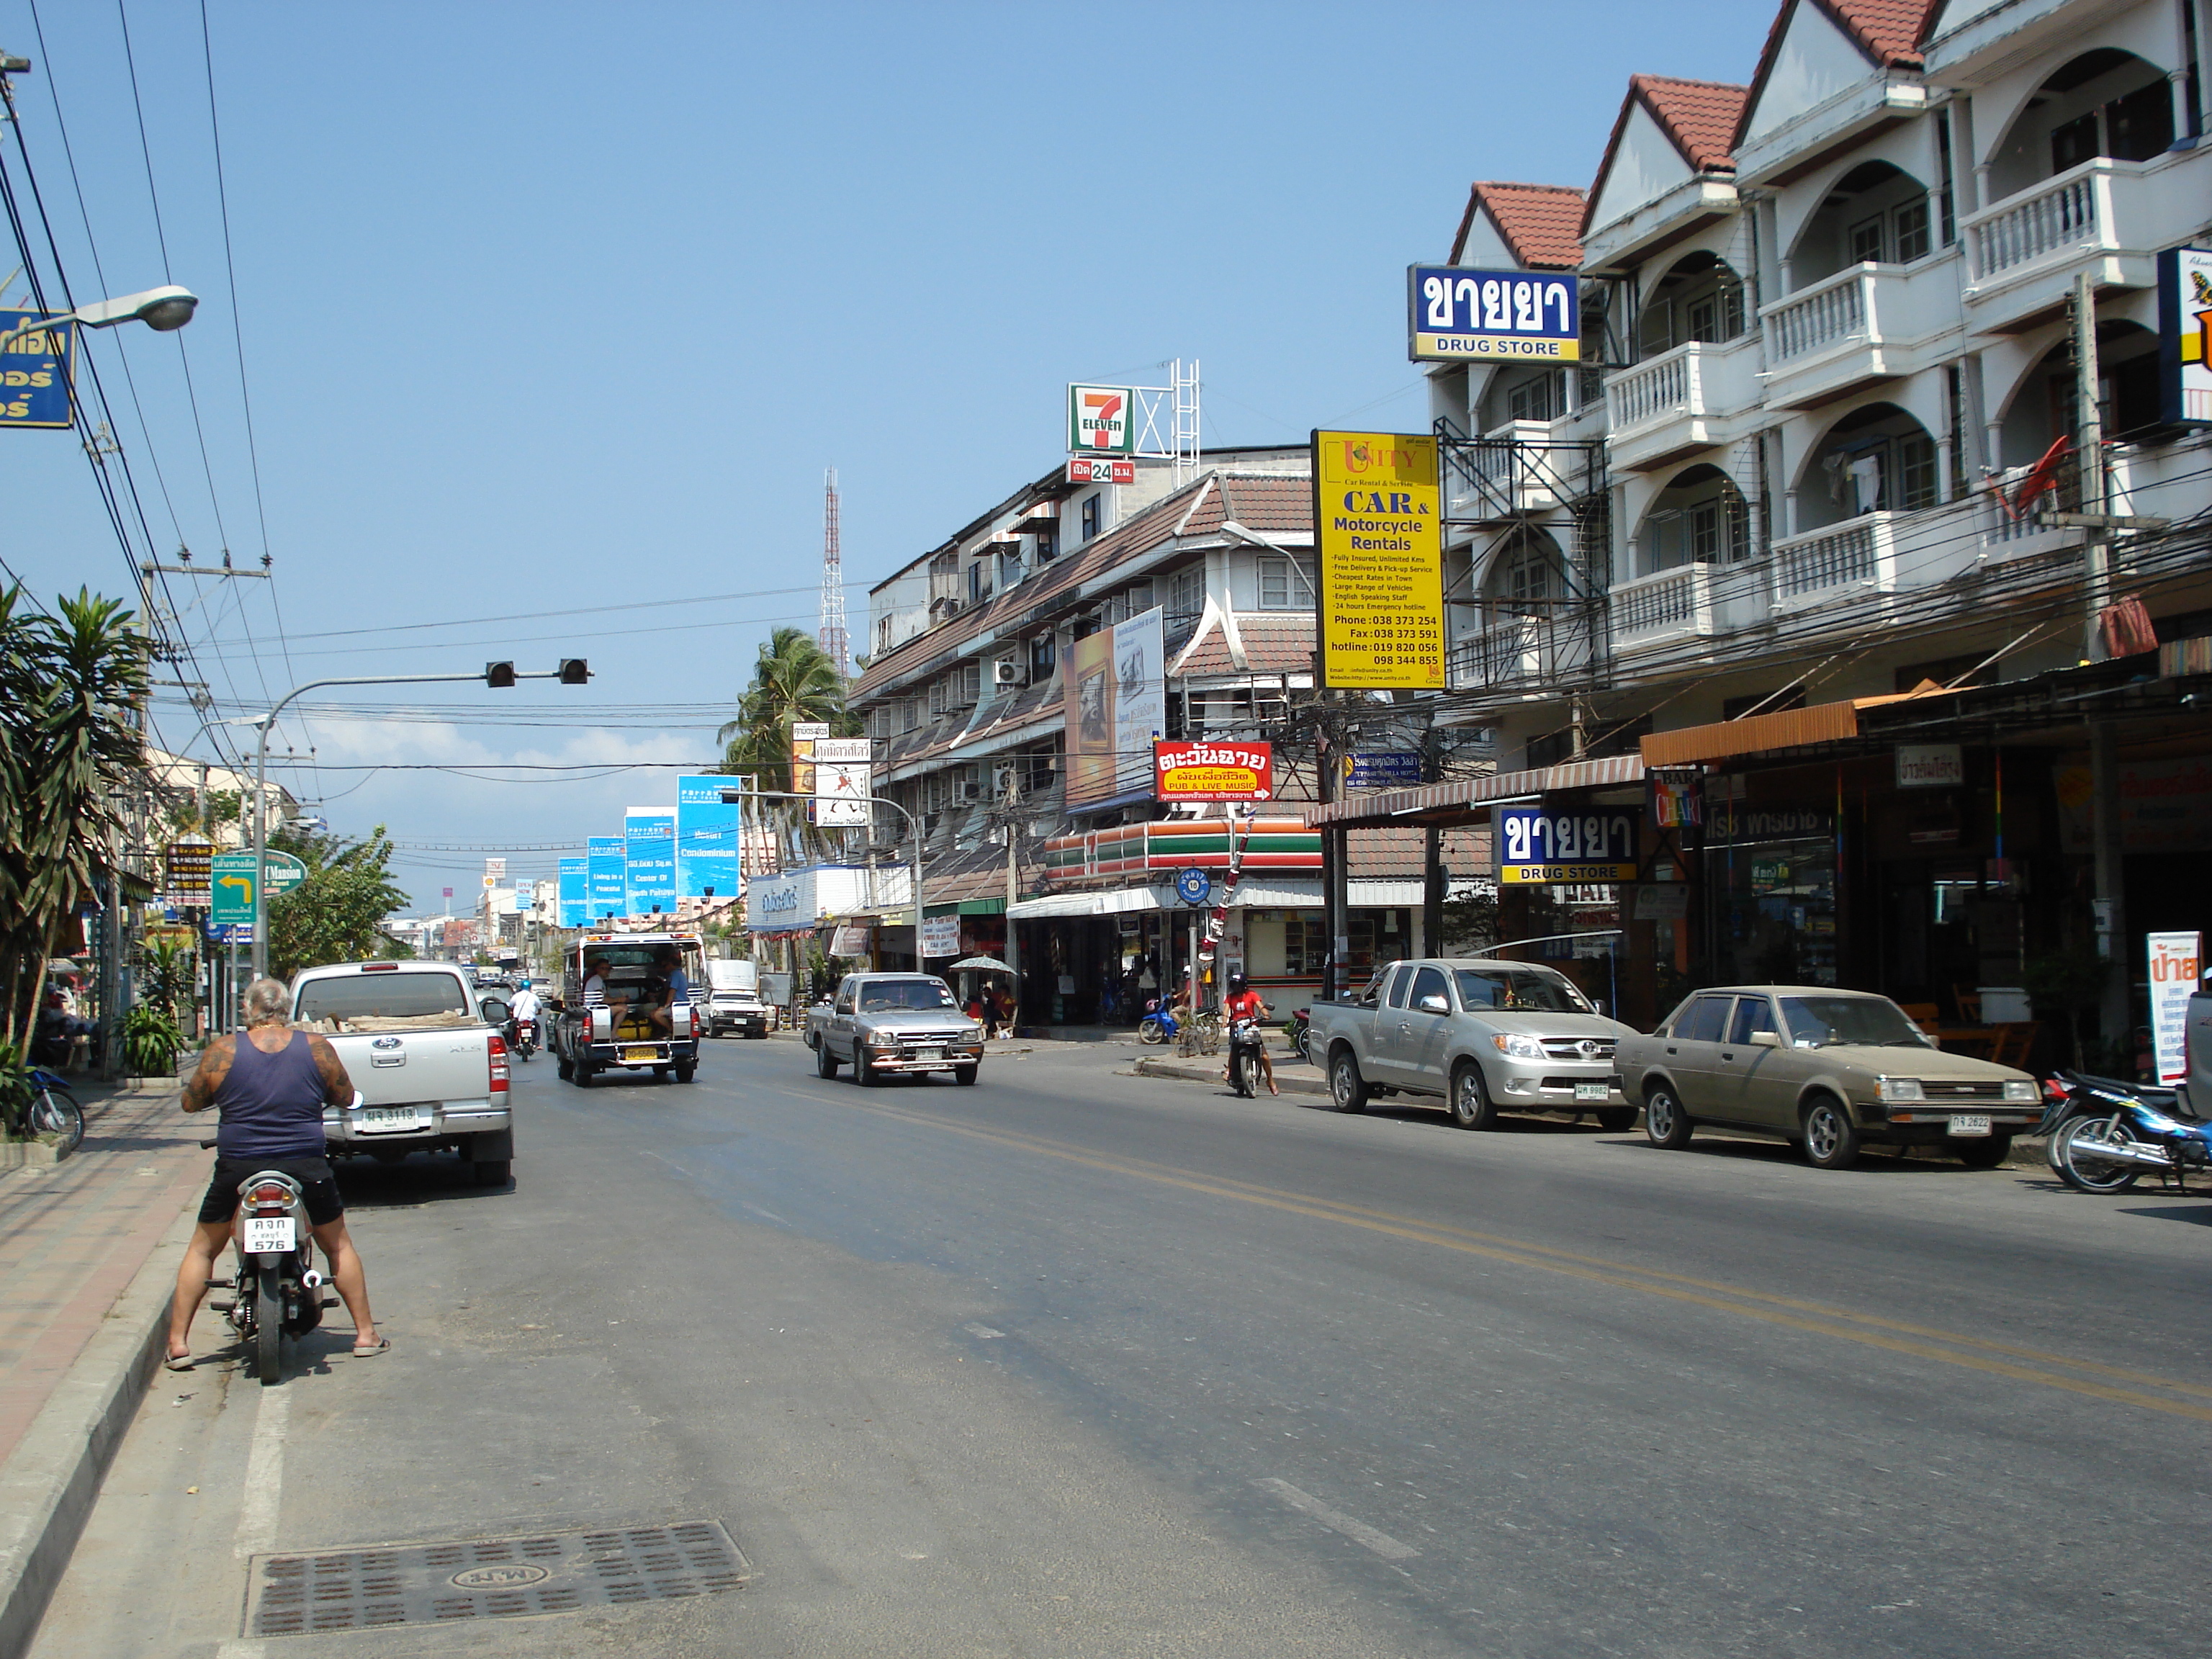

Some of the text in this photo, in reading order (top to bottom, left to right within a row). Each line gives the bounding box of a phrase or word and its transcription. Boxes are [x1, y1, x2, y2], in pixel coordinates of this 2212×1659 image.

[1424, 276, 1569, 332] ขายยา
[1437, 338, 1560, 355] DRUG STORE
[1341, 441, 1417, 473] UNITY
[1073, 463, 1090, 475] เปิด
[1092, 464, 1112, 480] 24
[1344, 491, 1430, 514] CAR &
[1334, 517, 1423, 535] Motorcycle
[1352, 536, 1411, 550] Rentals
[1395, 616, 1414, 625] 373
[1397, 629, 1416, 638] 373
[1419, 630, 1438, 639] 591
[1374, 656, 1393, 665] 098
[1397, 656, 1416, 665] 344
[1159, 742, 1266, 771] ตะวันฉาย
[1662, 772, 1696, 785] BAR
[1656, 793, 1702, 825] CHART
[1505, 816, 1632, 859] ขายยา
[269, 866, 301, 880] Mansion
[1521, 867, 1618, 878] DRUG STORE
[2152, 944, 2198, 982] ป้าย
[387, 1109, 413, 1121] 3113
[1953, 1117, 1988, 1127] กจ 2622
[255, 1220, 285, 1230] คจก
[255, 1241, 285, 1250] 576
